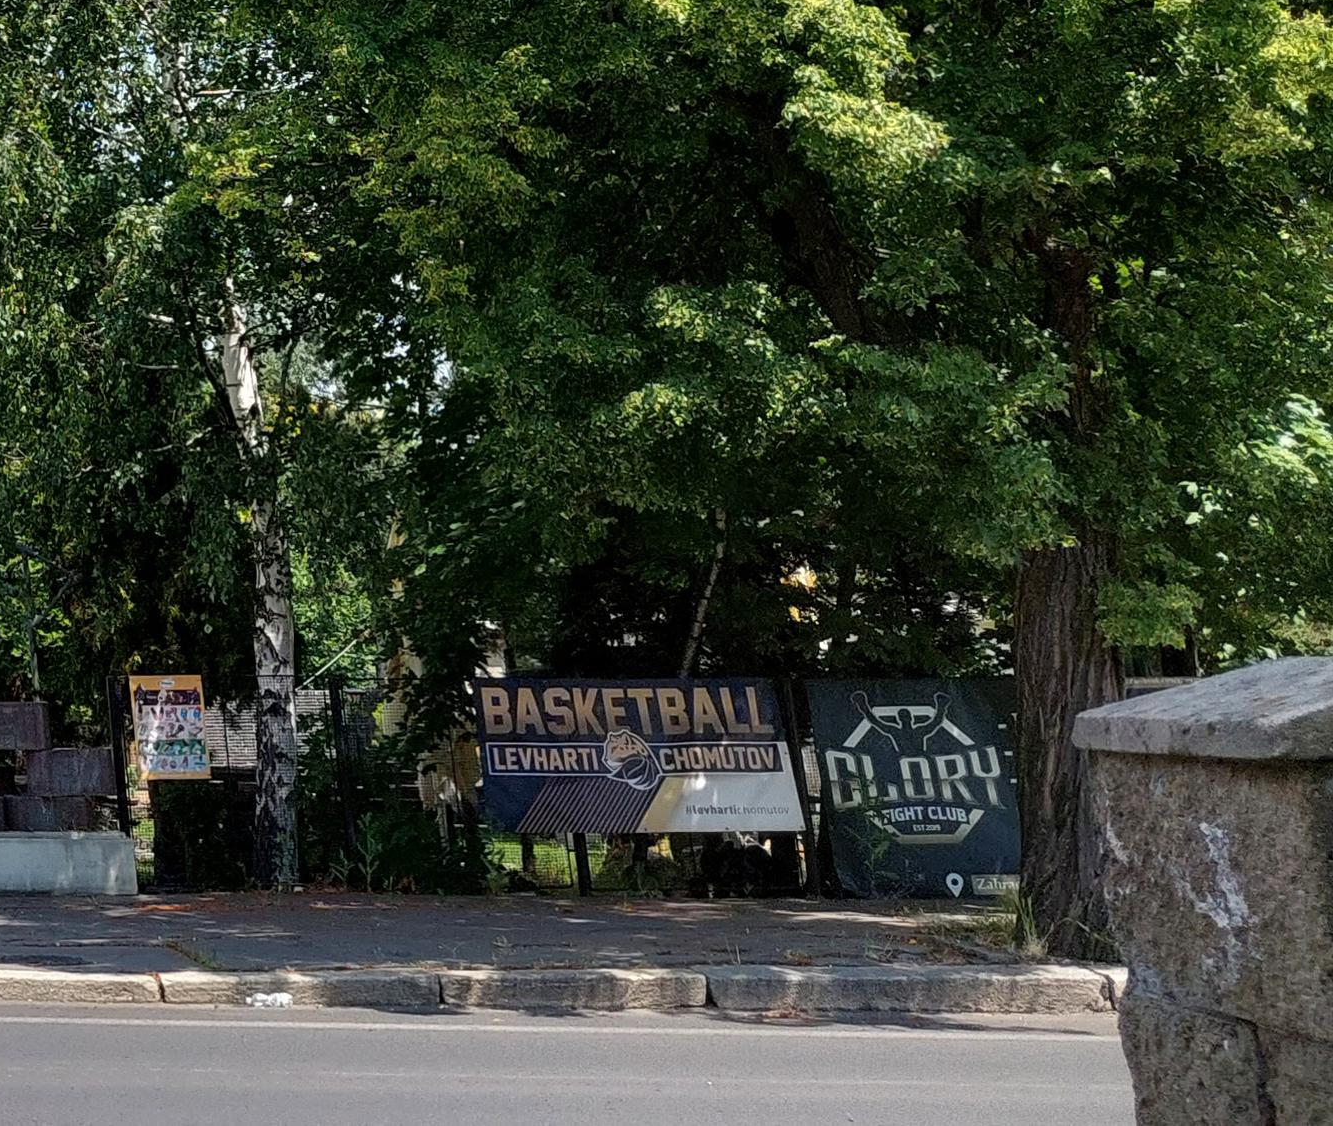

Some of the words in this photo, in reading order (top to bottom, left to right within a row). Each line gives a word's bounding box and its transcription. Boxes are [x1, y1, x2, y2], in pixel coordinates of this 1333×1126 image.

[481, 686, 774, 735] BASKETBALL
[492, 745, 600, 772] LEVHARTI
[659, 745, 775, 770] CHOMUTOV
[825, 746, 1005, 810] GLORY
[881, 806, 924, 824] FIGHT
[927, 806, 968, 823] CLUB
